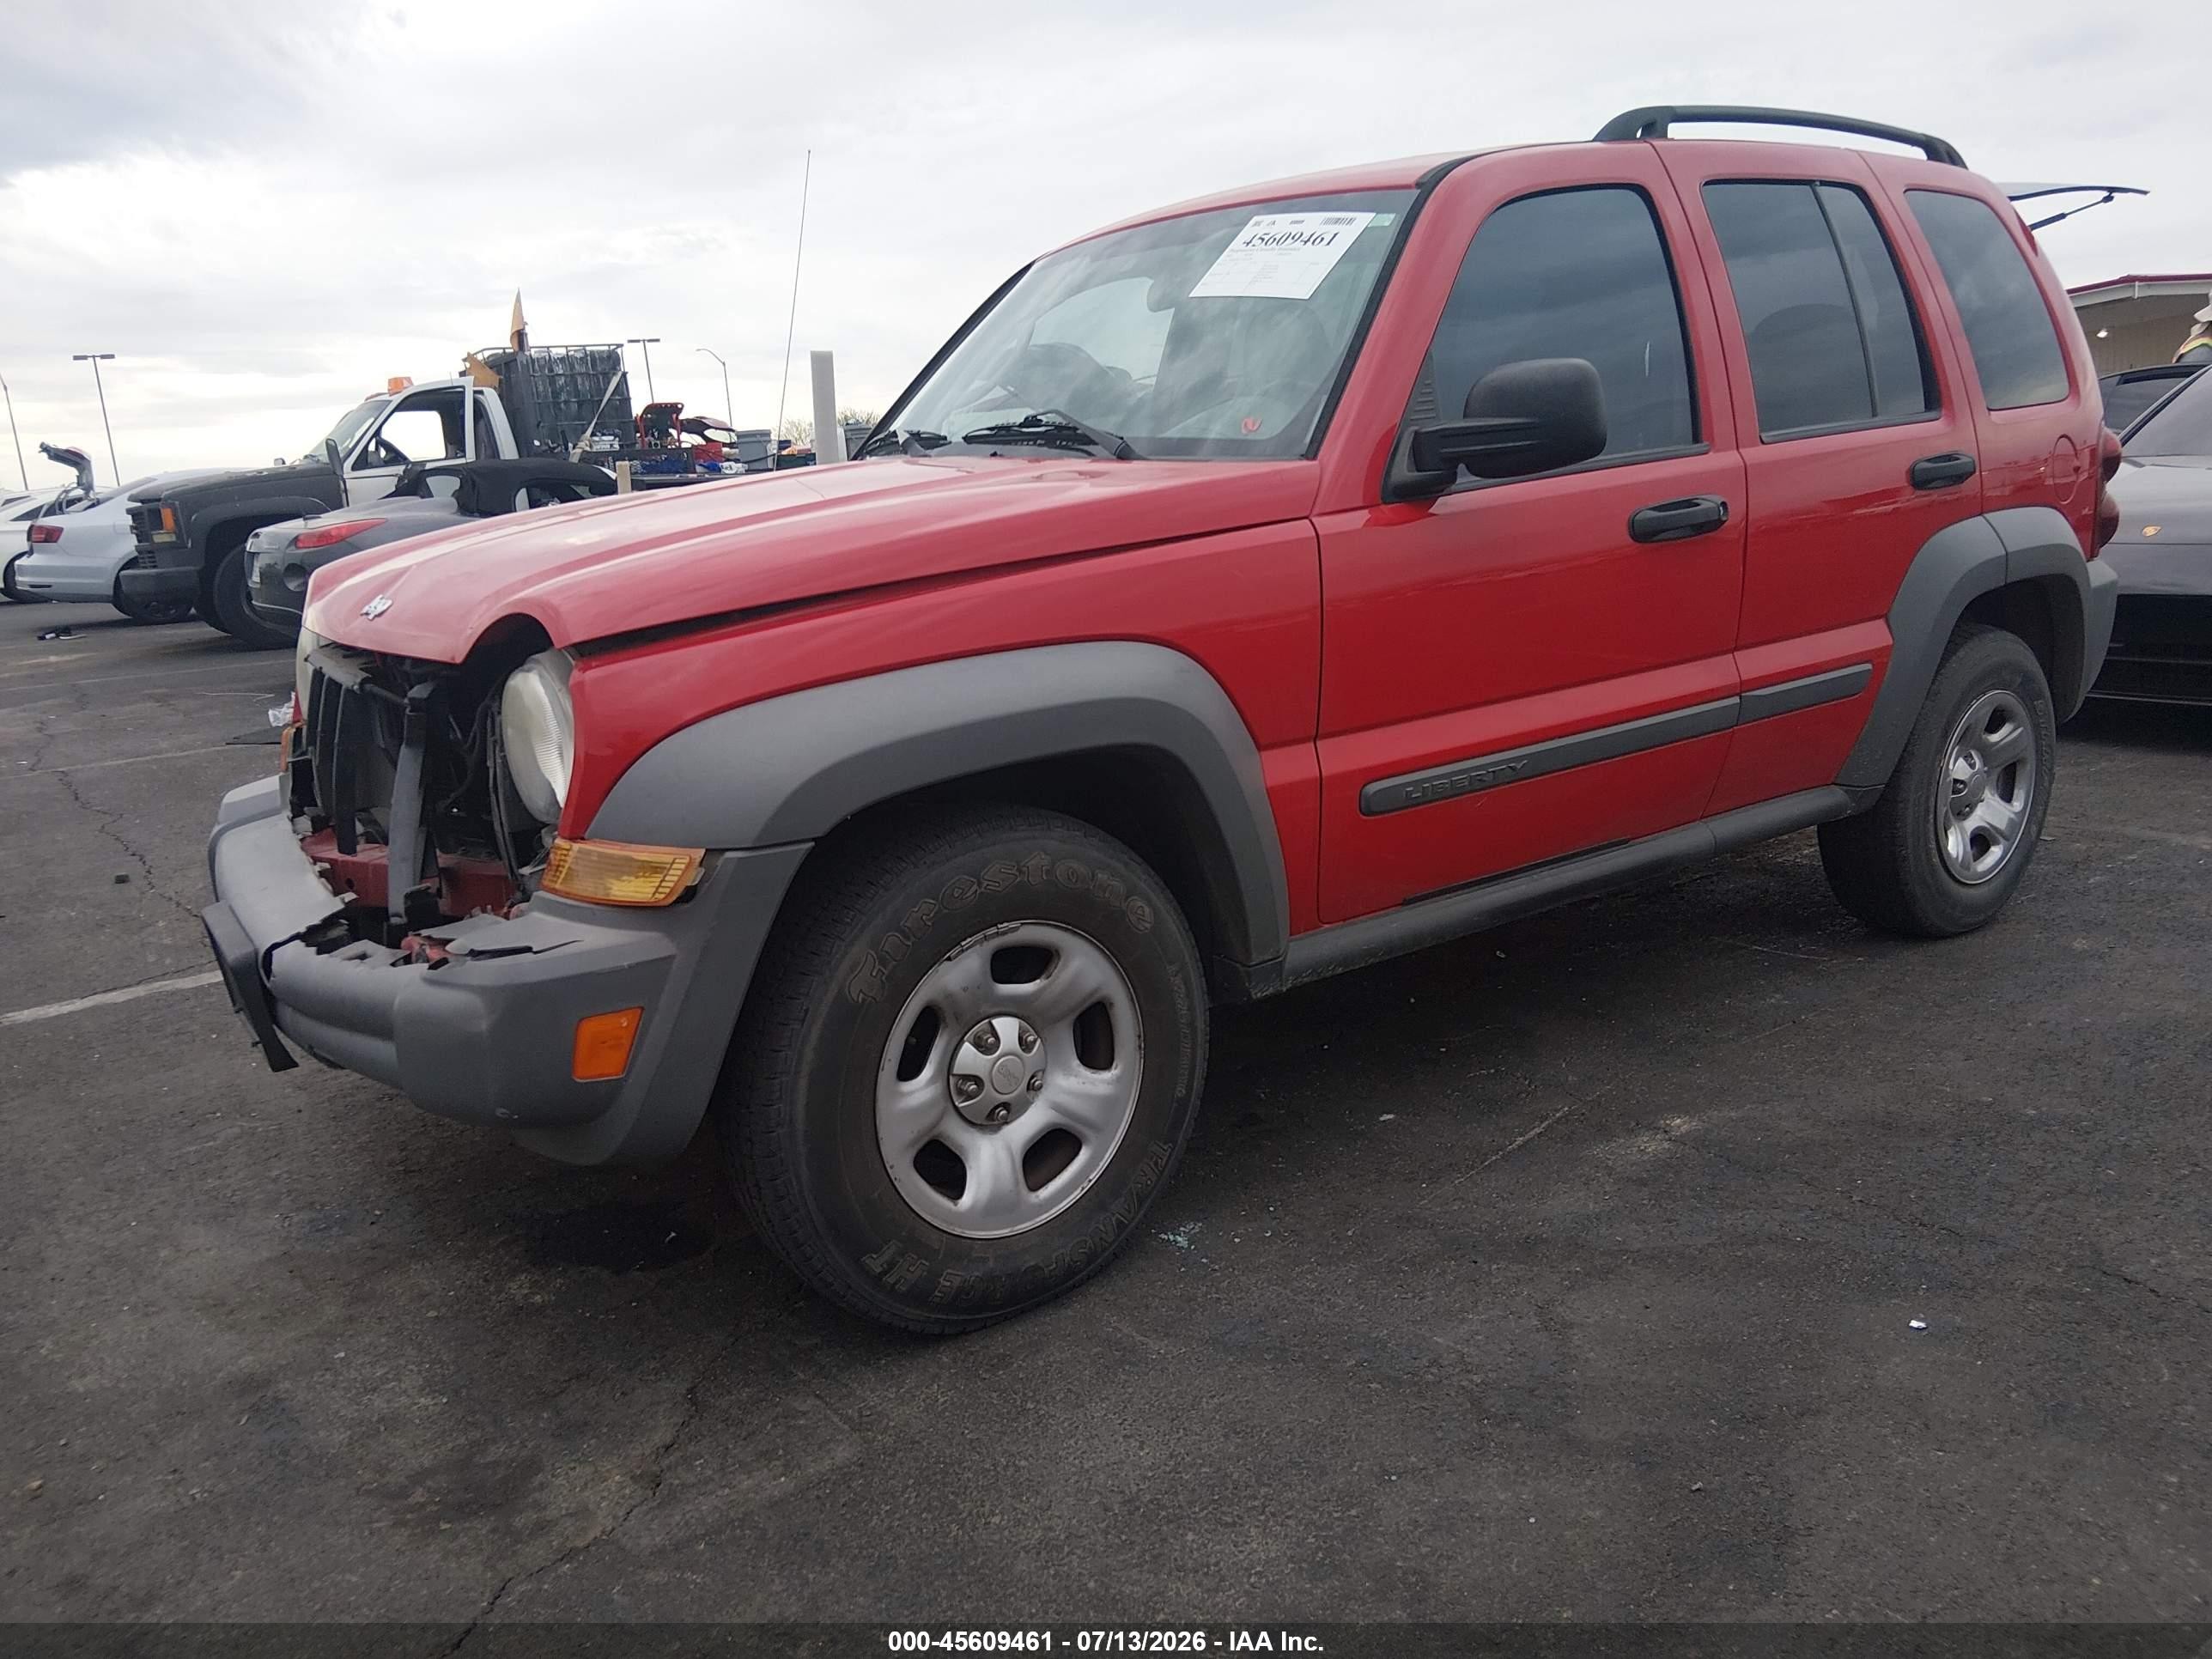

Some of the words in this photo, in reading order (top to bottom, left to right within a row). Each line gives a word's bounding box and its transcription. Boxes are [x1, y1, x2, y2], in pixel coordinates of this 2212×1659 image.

[1243, 231, 1340, 247] 45609461
[1404, 760, 1528, 799] LIBERTY
[846, 850, 1155, 1004] Firestone
[860, 1239, 930, 1294] HT
